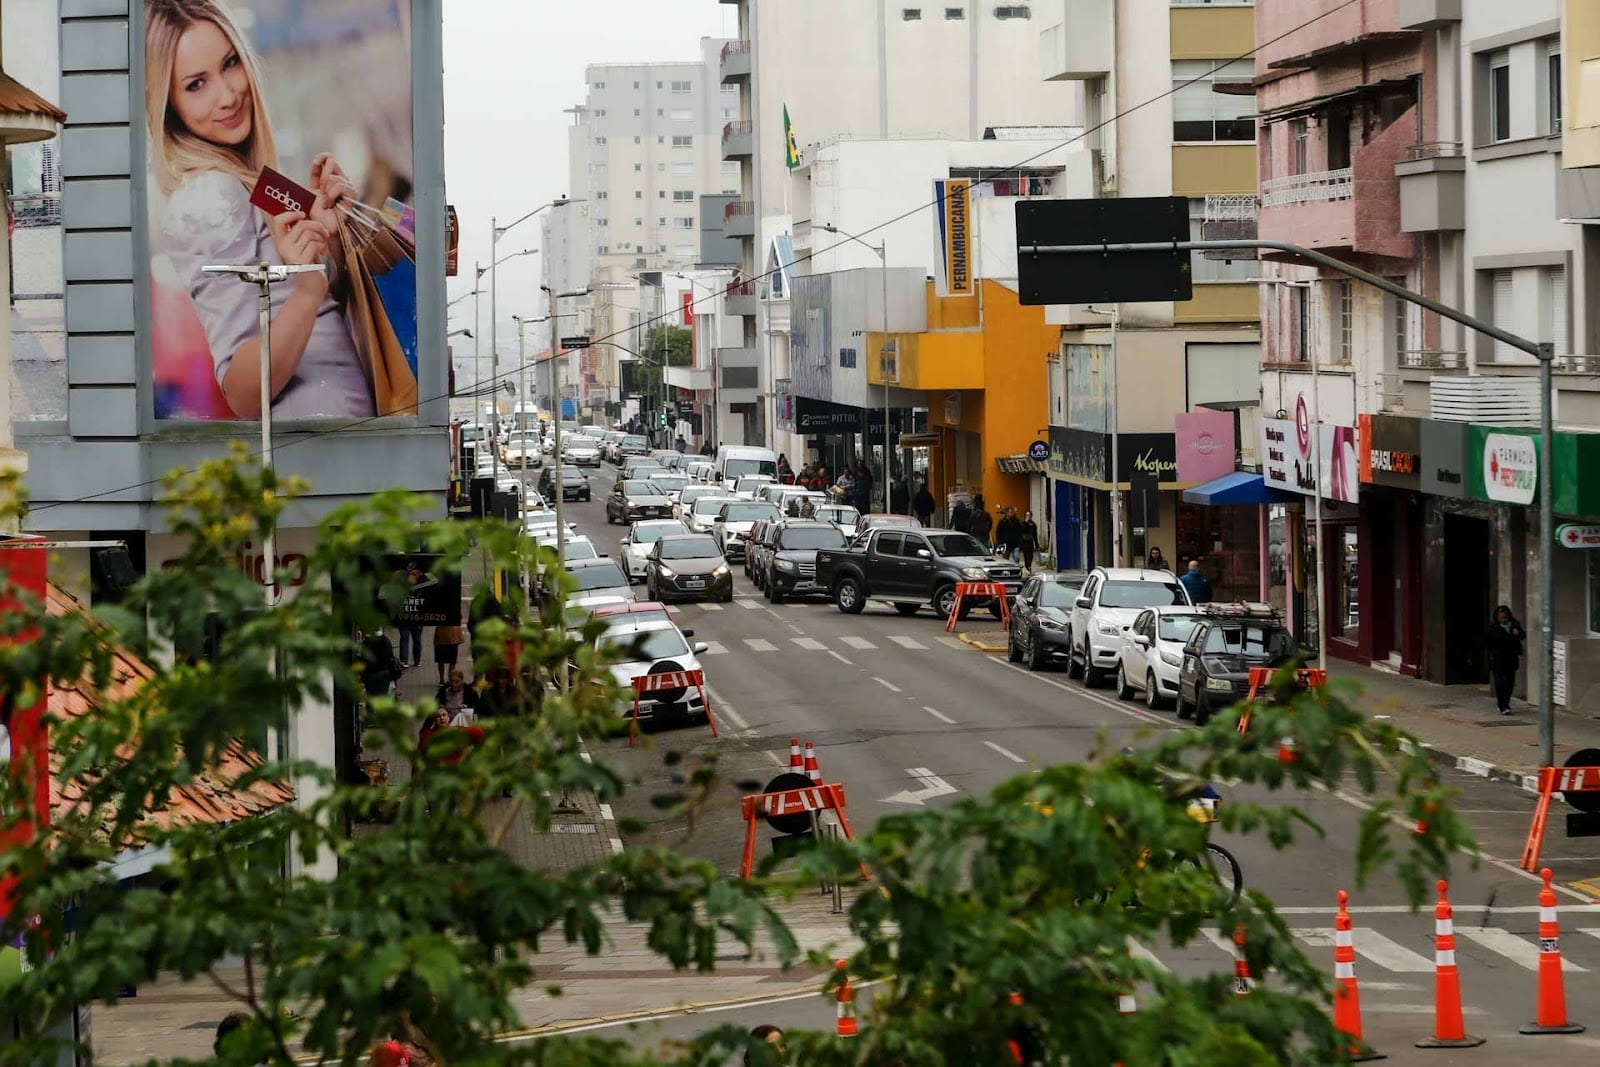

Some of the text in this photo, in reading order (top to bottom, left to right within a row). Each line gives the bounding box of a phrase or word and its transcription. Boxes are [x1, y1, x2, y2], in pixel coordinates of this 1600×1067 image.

[265, 185, 302, 211] código
[950, 184, 967, 290] PERNAMBUCANAS
[832, 413, 857, 423] PITTOL
